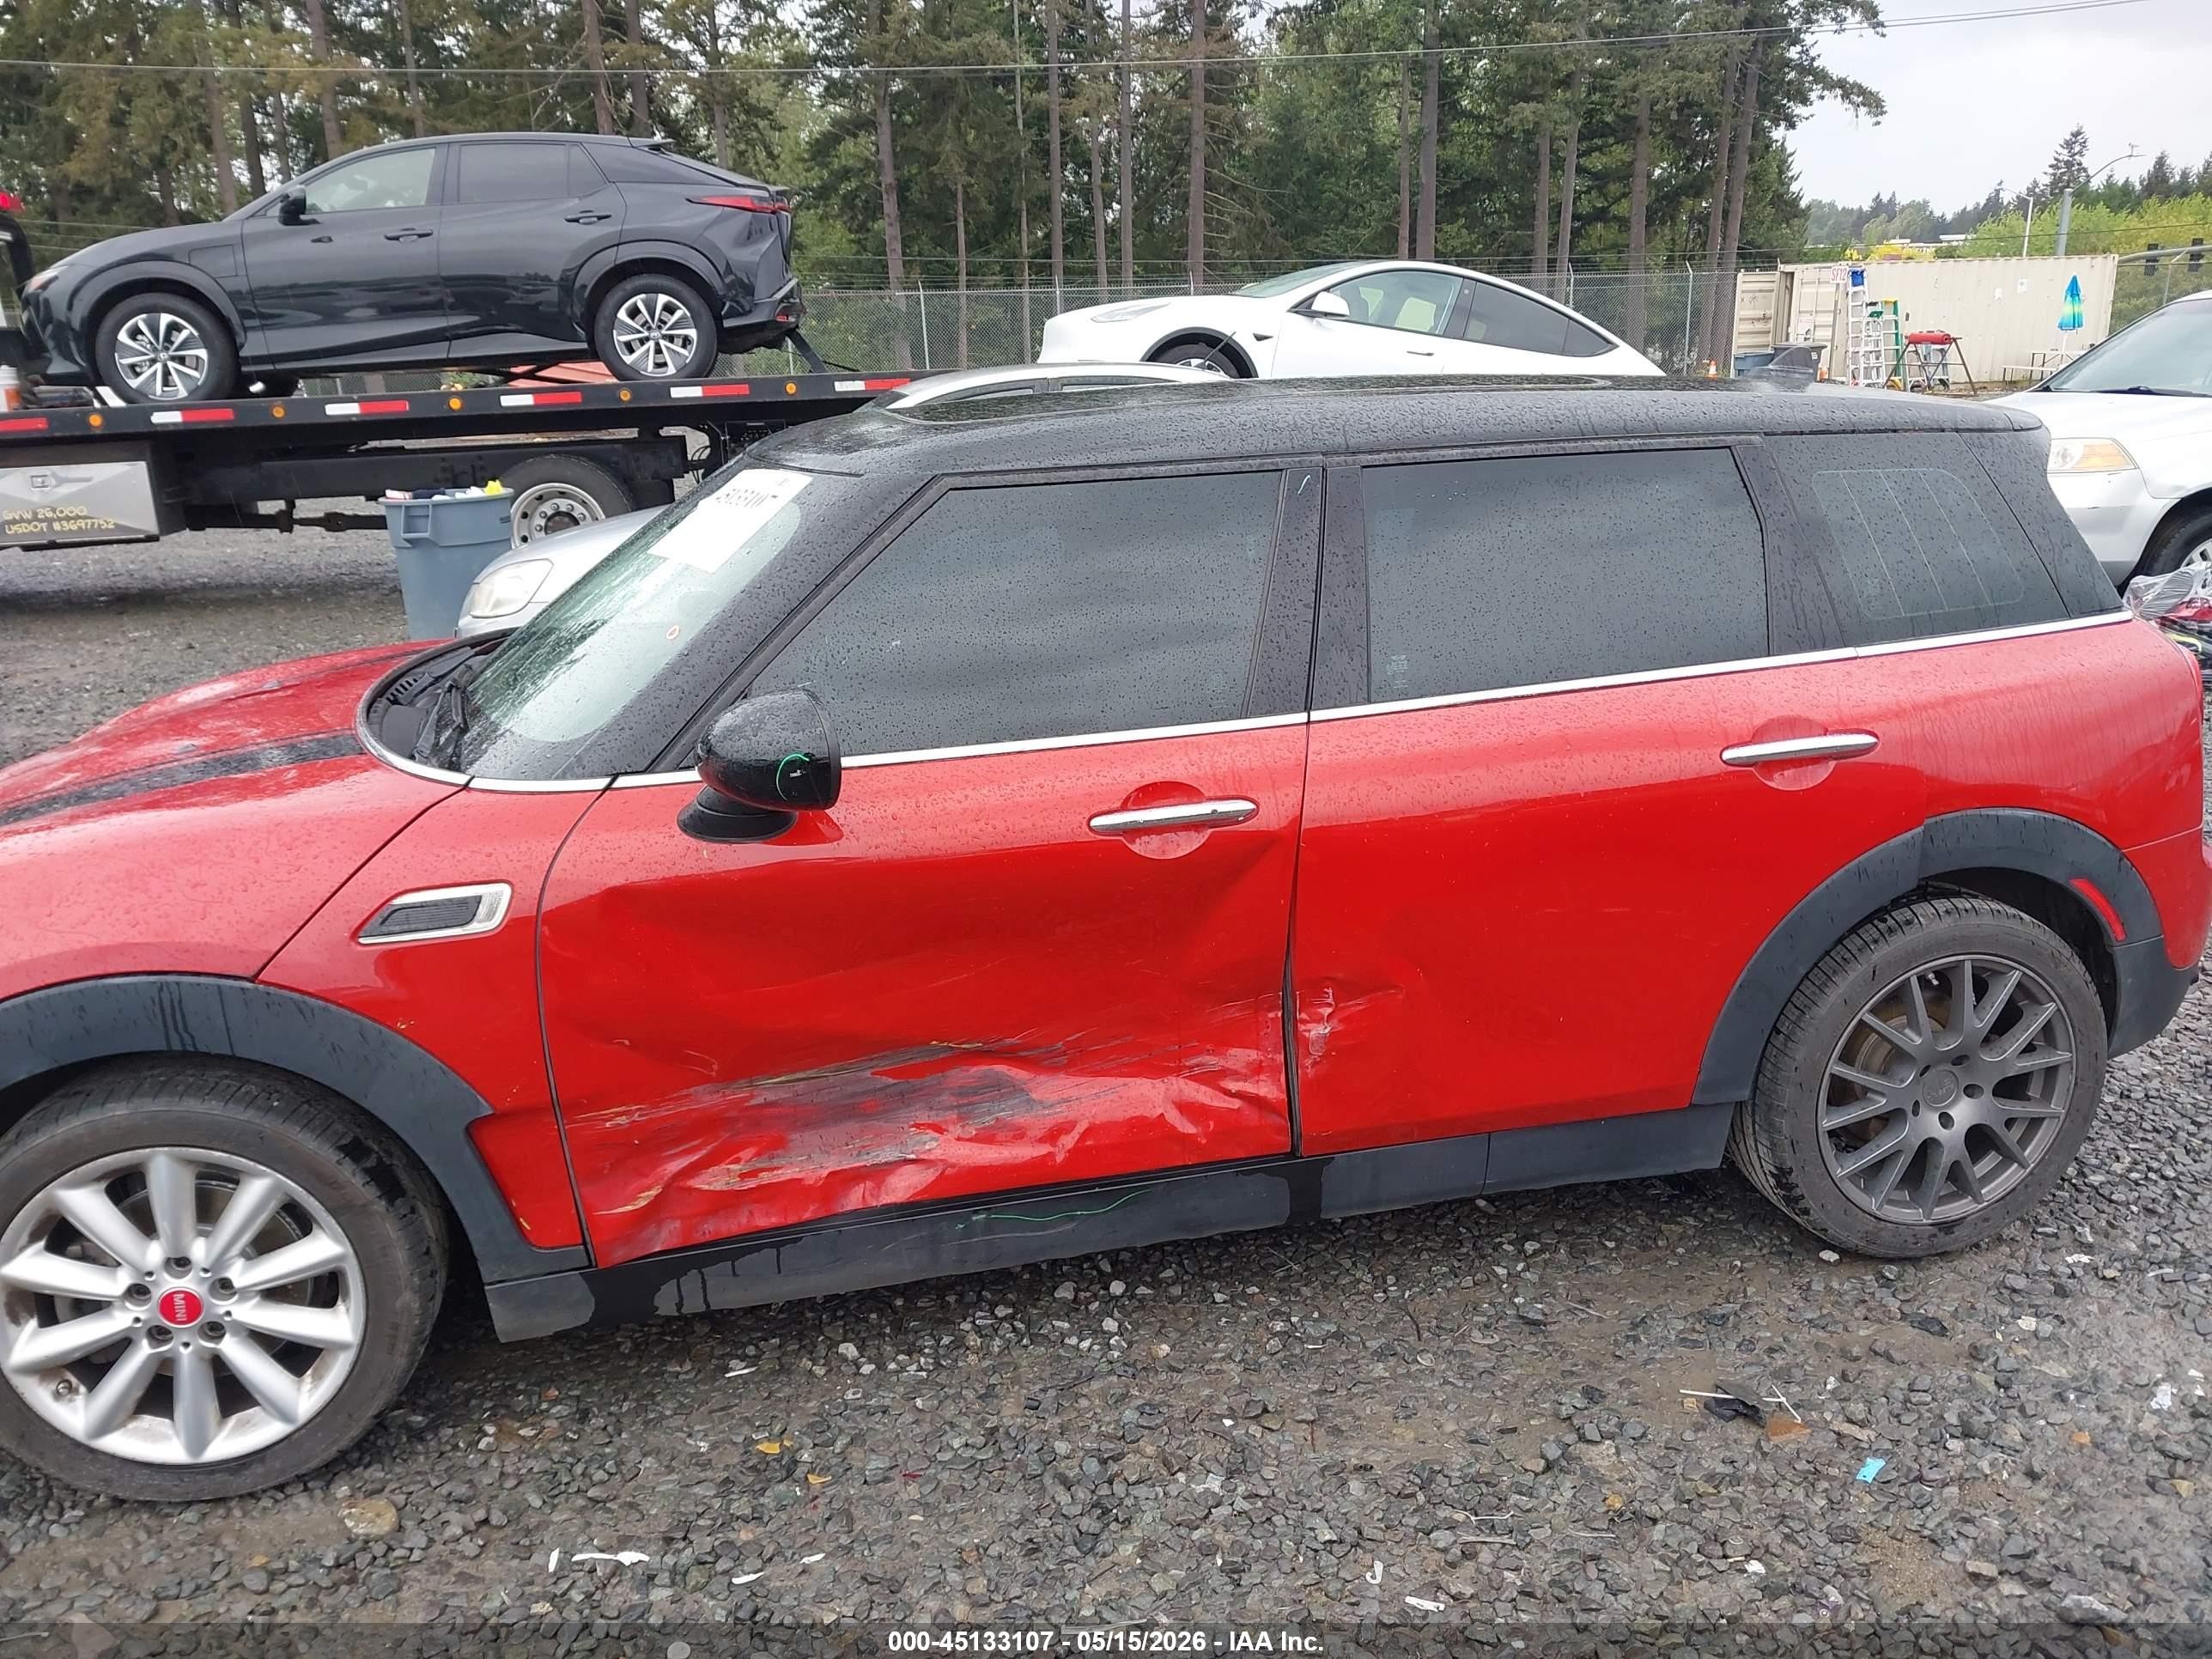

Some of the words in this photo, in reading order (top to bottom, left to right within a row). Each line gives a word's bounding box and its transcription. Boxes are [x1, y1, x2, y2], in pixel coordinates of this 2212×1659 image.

[37, 505, 87, 519] 26,000
[5, 521, 48, 534] USDOT
[173, 1293, 187, 1322] MINI
